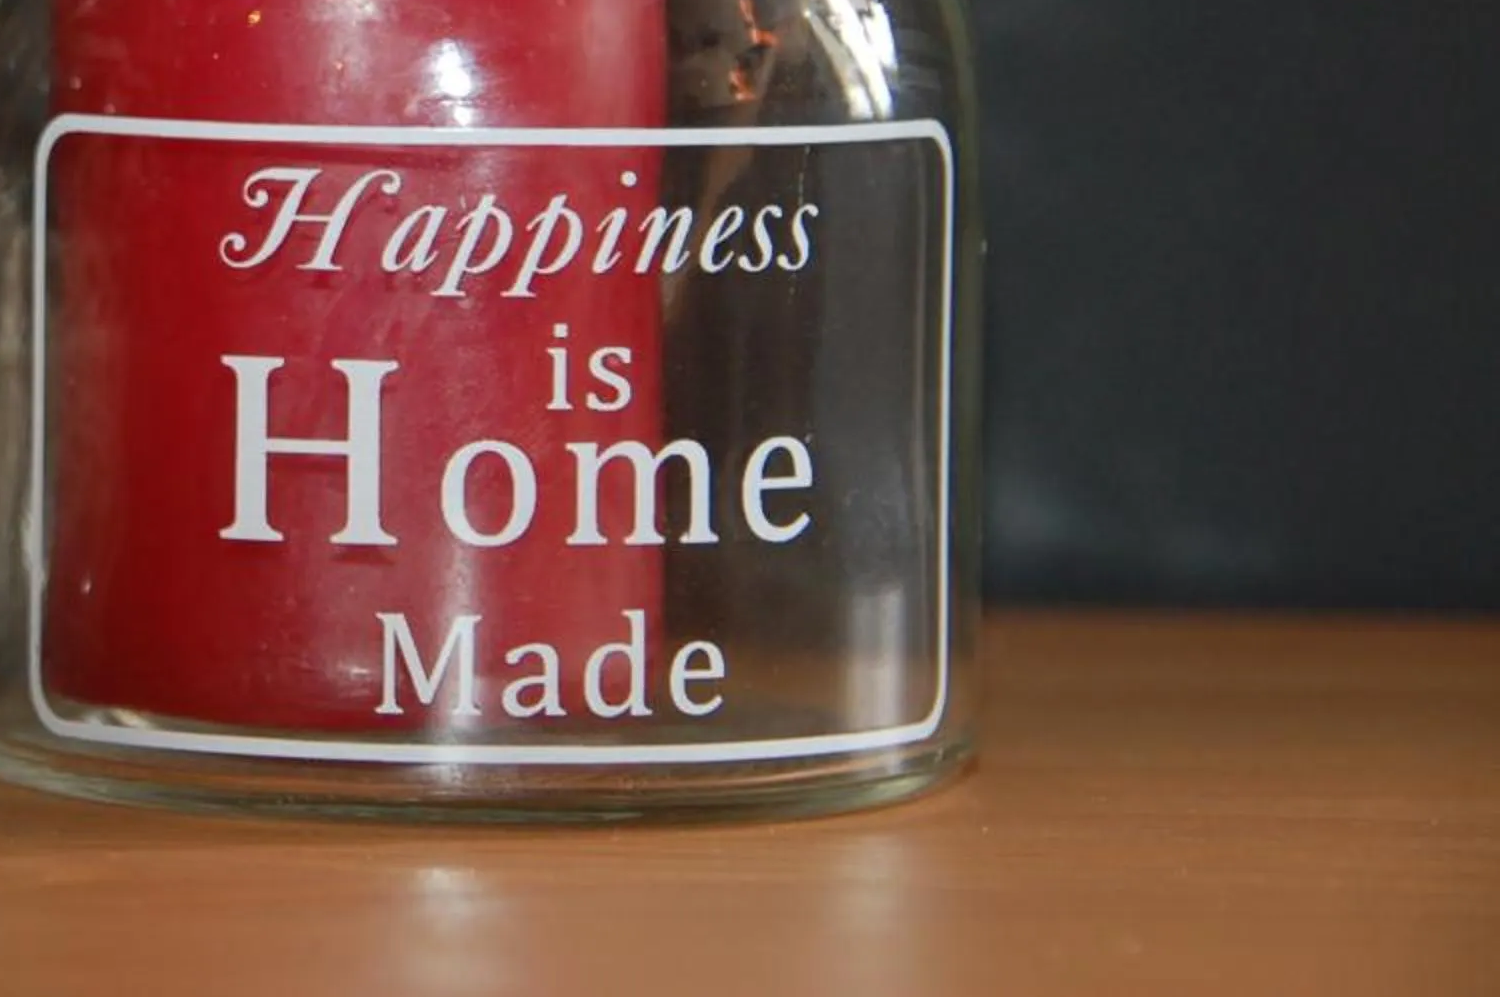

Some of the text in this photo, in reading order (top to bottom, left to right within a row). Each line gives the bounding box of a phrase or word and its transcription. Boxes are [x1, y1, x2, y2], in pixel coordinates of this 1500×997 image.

[219, 167, 818, 298] Happiness
[547, 324, 632, 411] is
[219, 355, 812, 547] Home
[375, 610, 725, 717] Made
